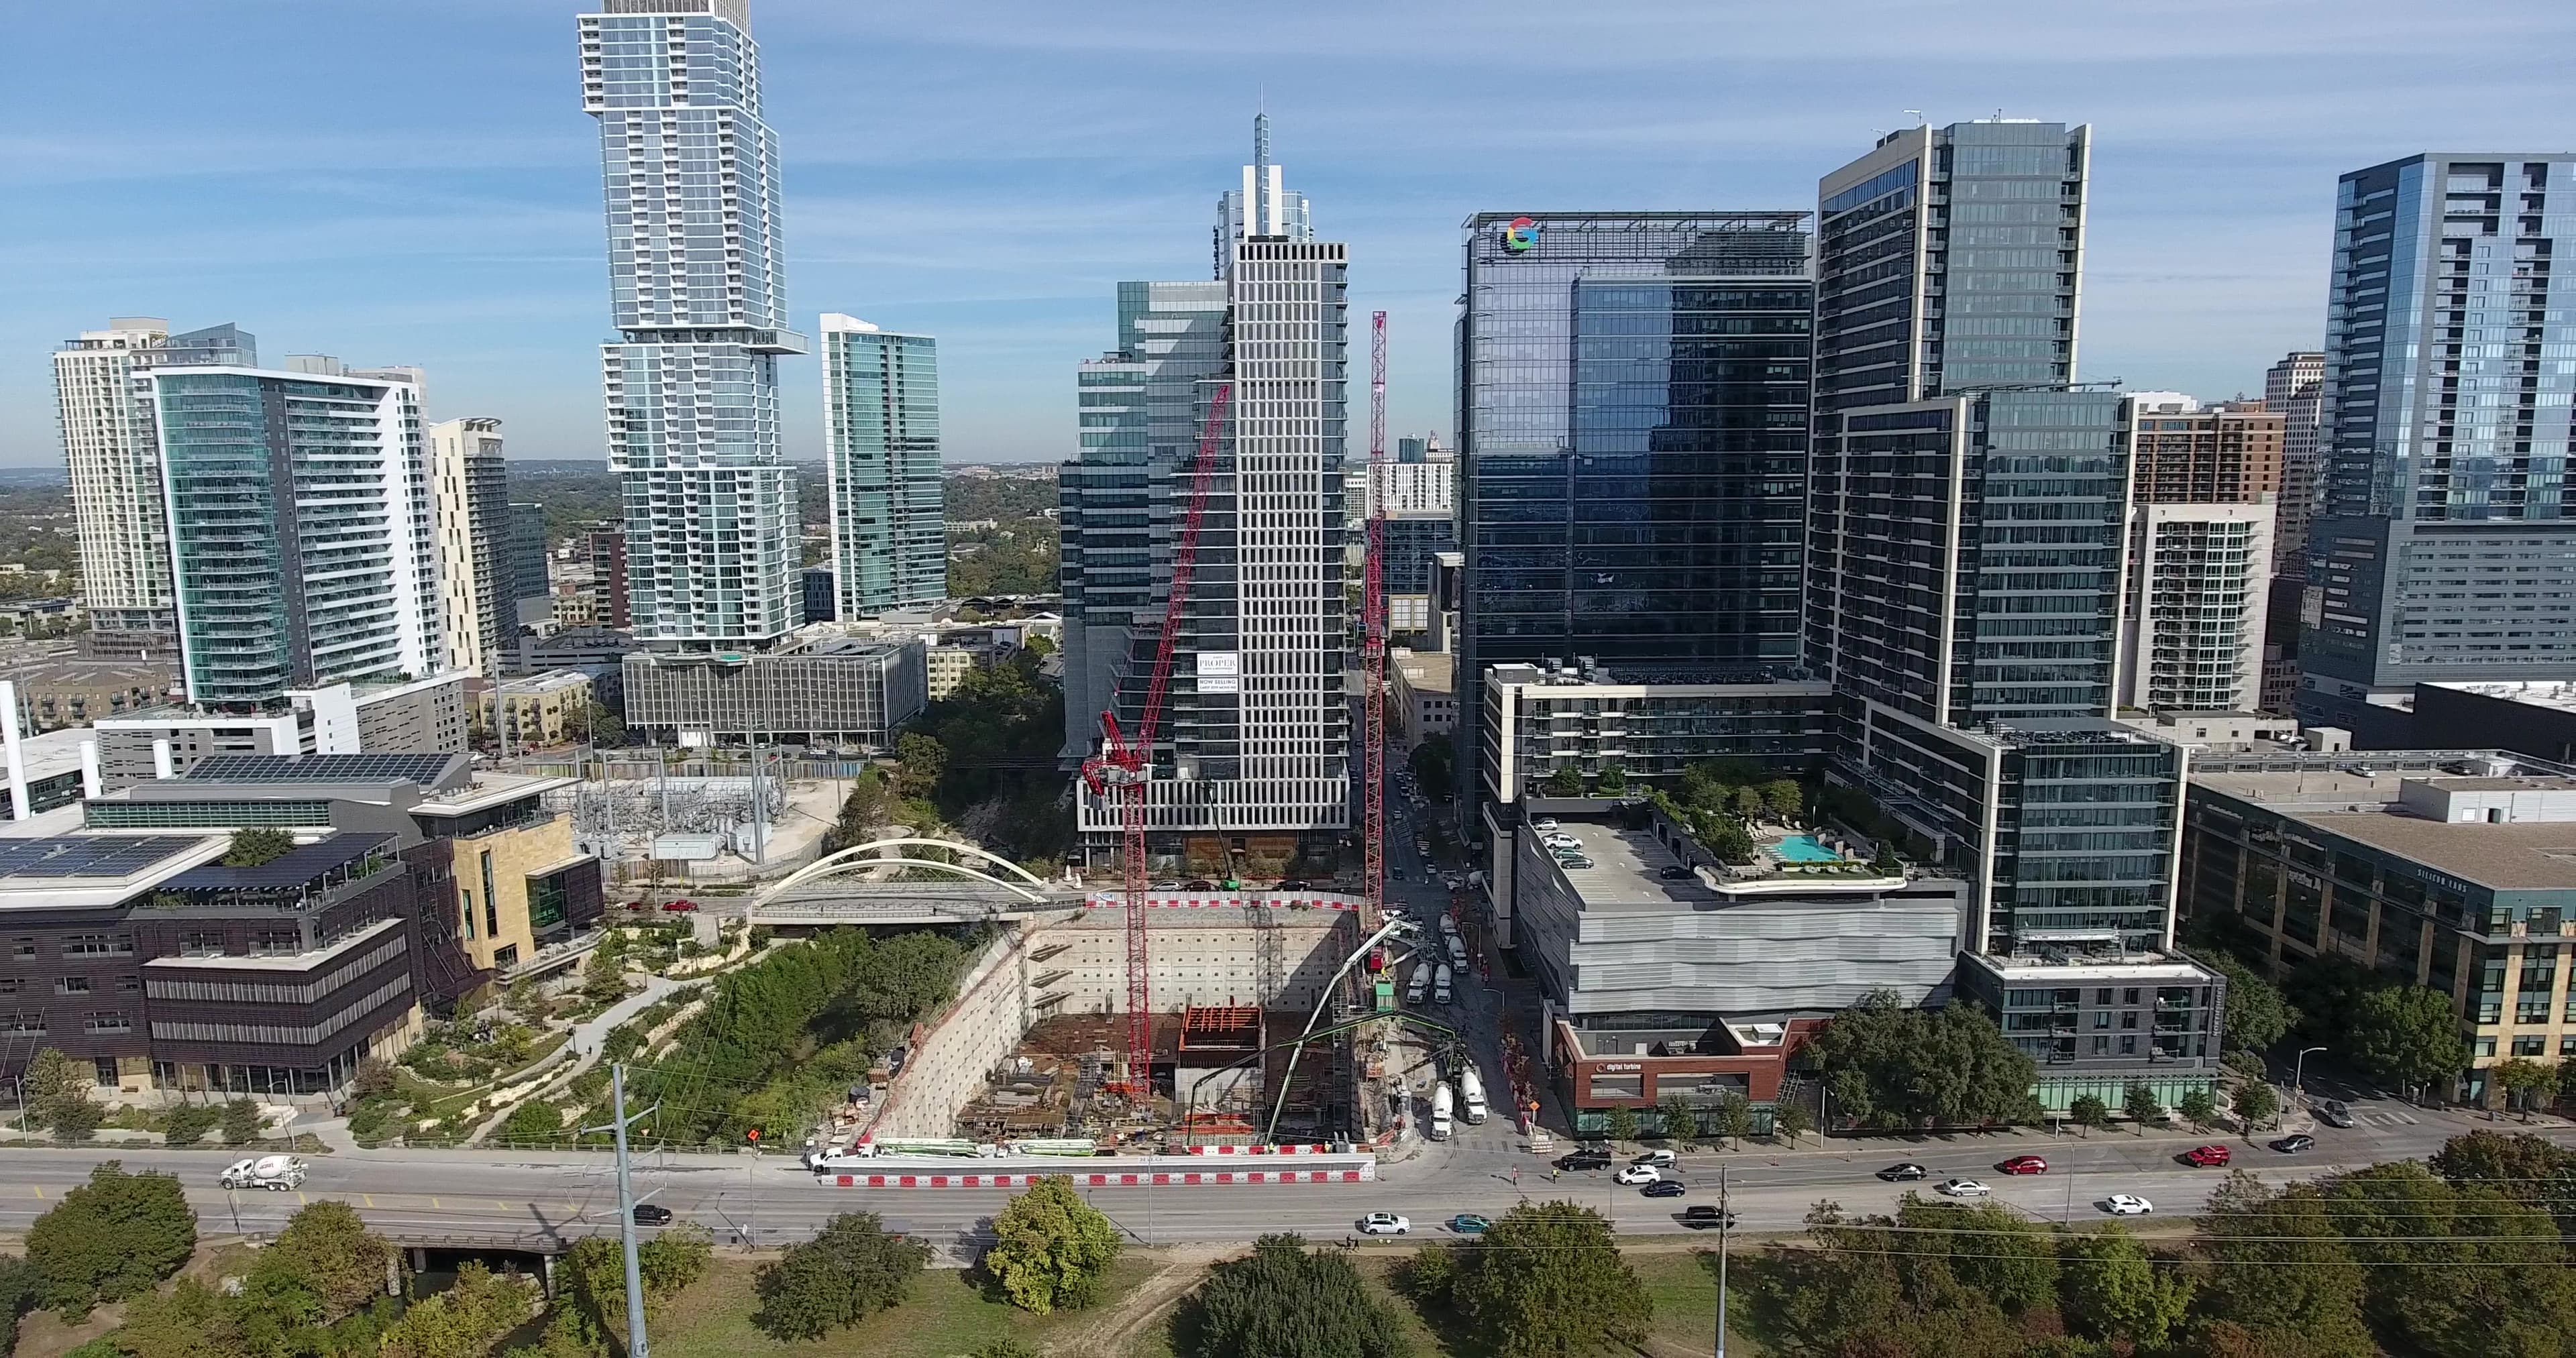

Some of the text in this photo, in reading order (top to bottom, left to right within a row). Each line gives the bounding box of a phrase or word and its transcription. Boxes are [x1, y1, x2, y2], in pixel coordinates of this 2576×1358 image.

[2417, 869, 2467, 893] SILICON LABS
[1607, 1063, 1623, 1072] digital
